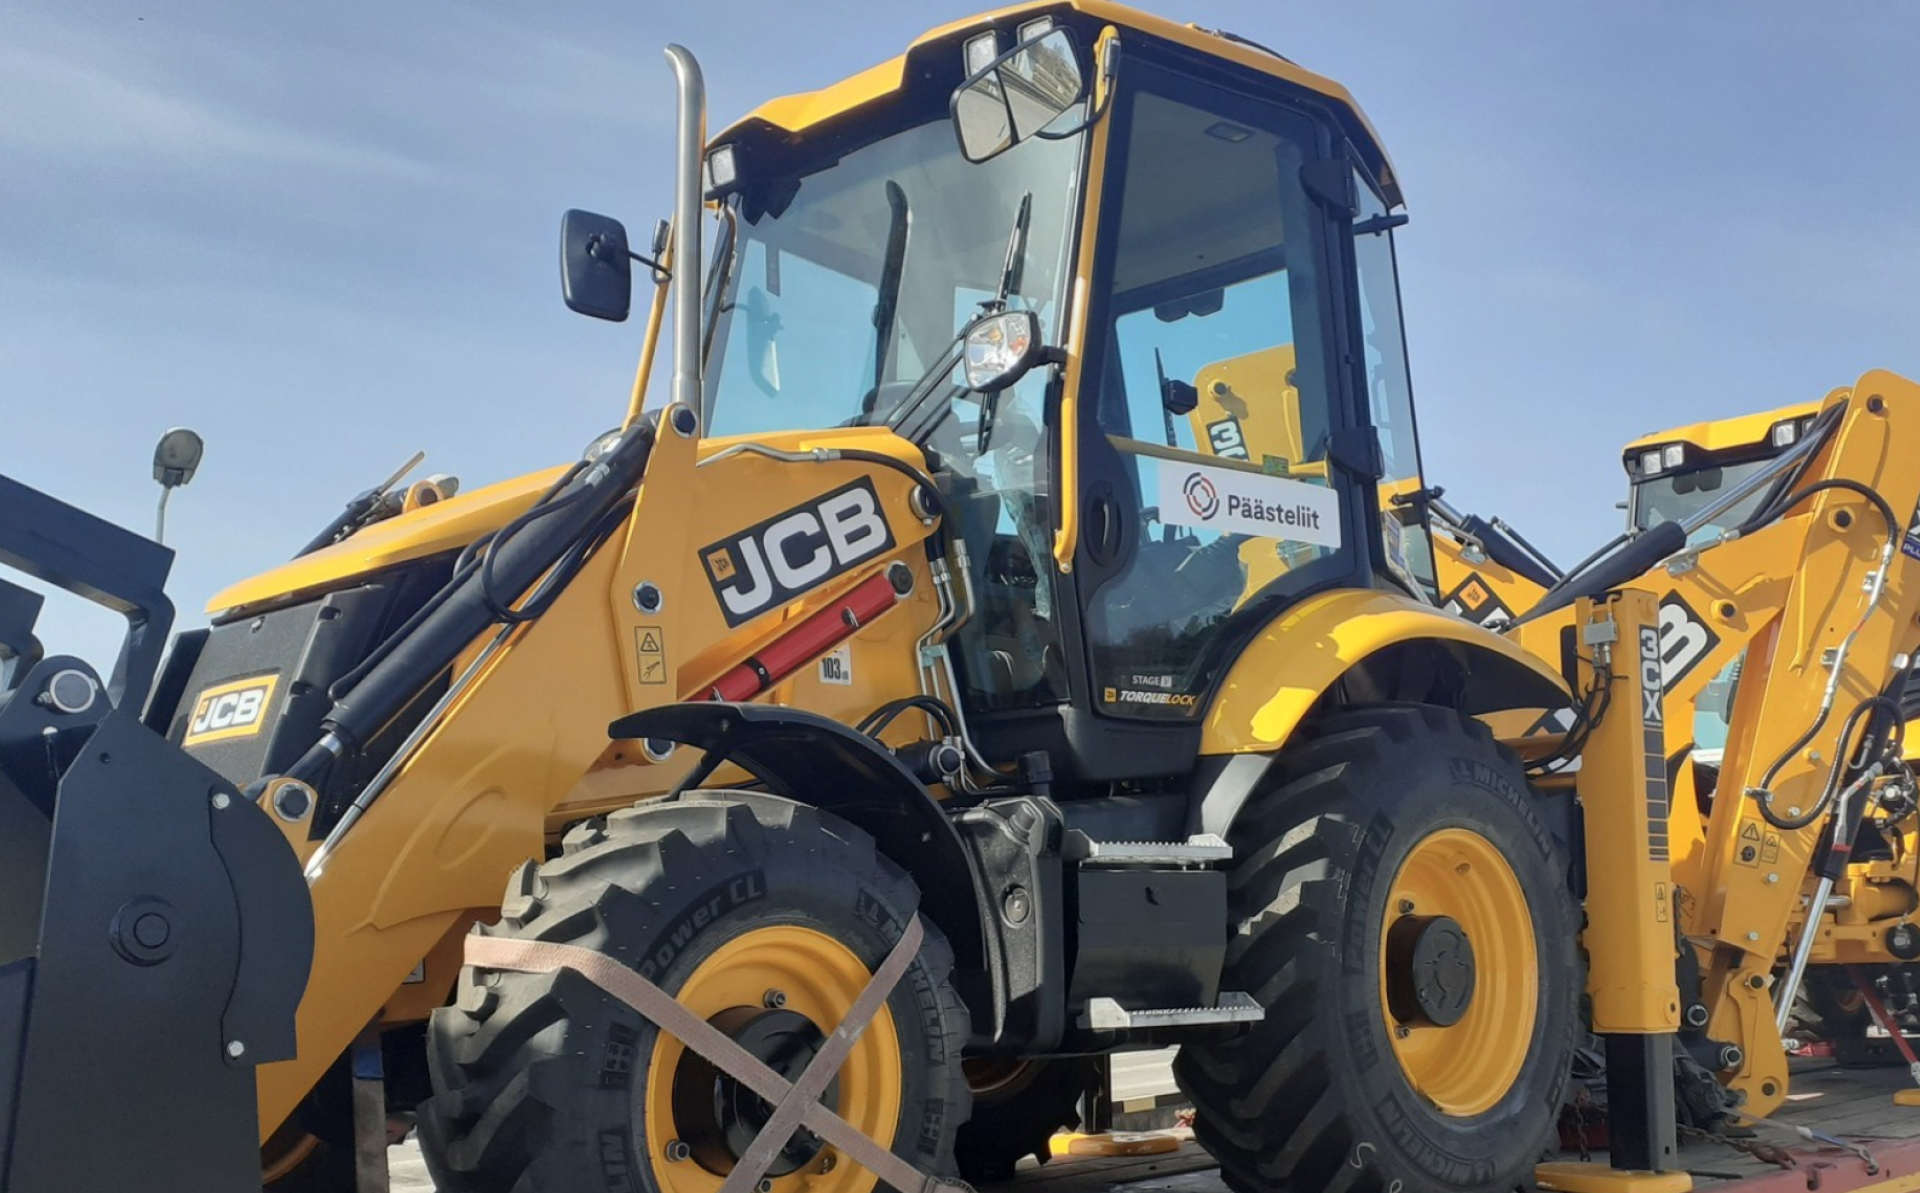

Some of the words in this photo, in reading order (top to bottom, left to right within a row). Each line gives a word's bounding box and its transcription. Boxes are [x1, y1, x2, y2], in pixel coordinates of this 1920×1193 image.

[1228, 494, 1320, 531] Päästeliit
[721, 487, 887, 614] JCB
[822, 657, 840, 679] 103
[1132, 675, 1160, 686] STAGE
[1641, 628, 1662, 720] 3CX
[193, 689, 264, 733] JCB
[1120, 690, 1196, 706] TORQUELOCK
[1473, 762, 1552, 857] MICHELIN
[729, 875, 762, 904] CL
[1376, 1099, 1473, 1185] MICHELIN
